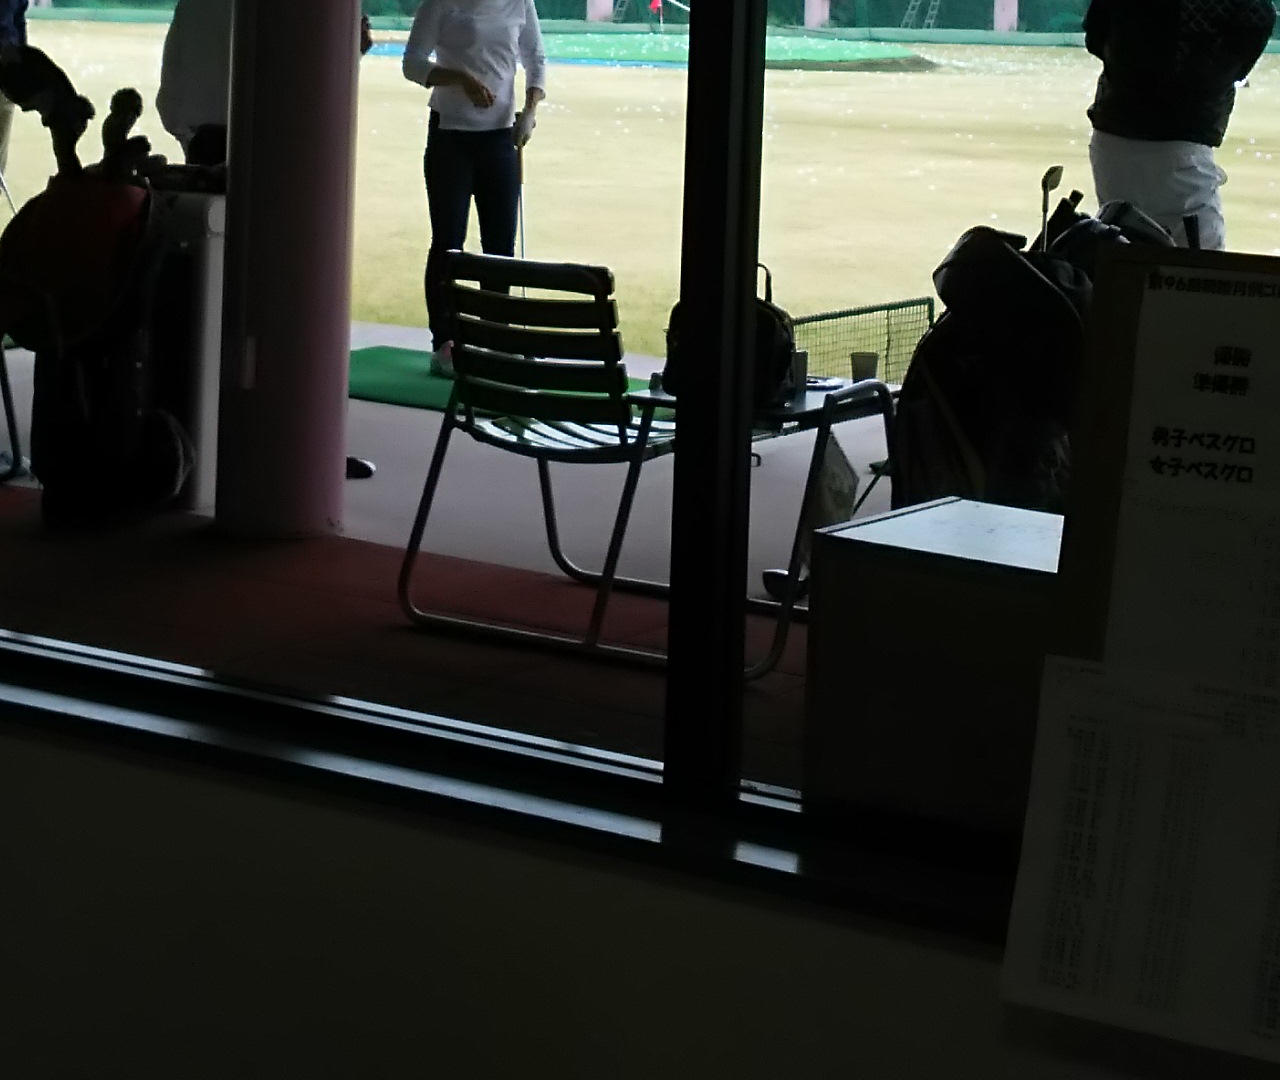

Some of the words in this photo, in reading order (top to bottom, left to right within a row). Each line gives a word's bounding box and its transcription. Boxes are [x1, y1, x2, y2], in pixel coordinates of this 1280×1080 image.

[1152, 425, 1256, 454] 男子ベスグロ
[1149, 455, 1254, 483] 女子ベスグロ
